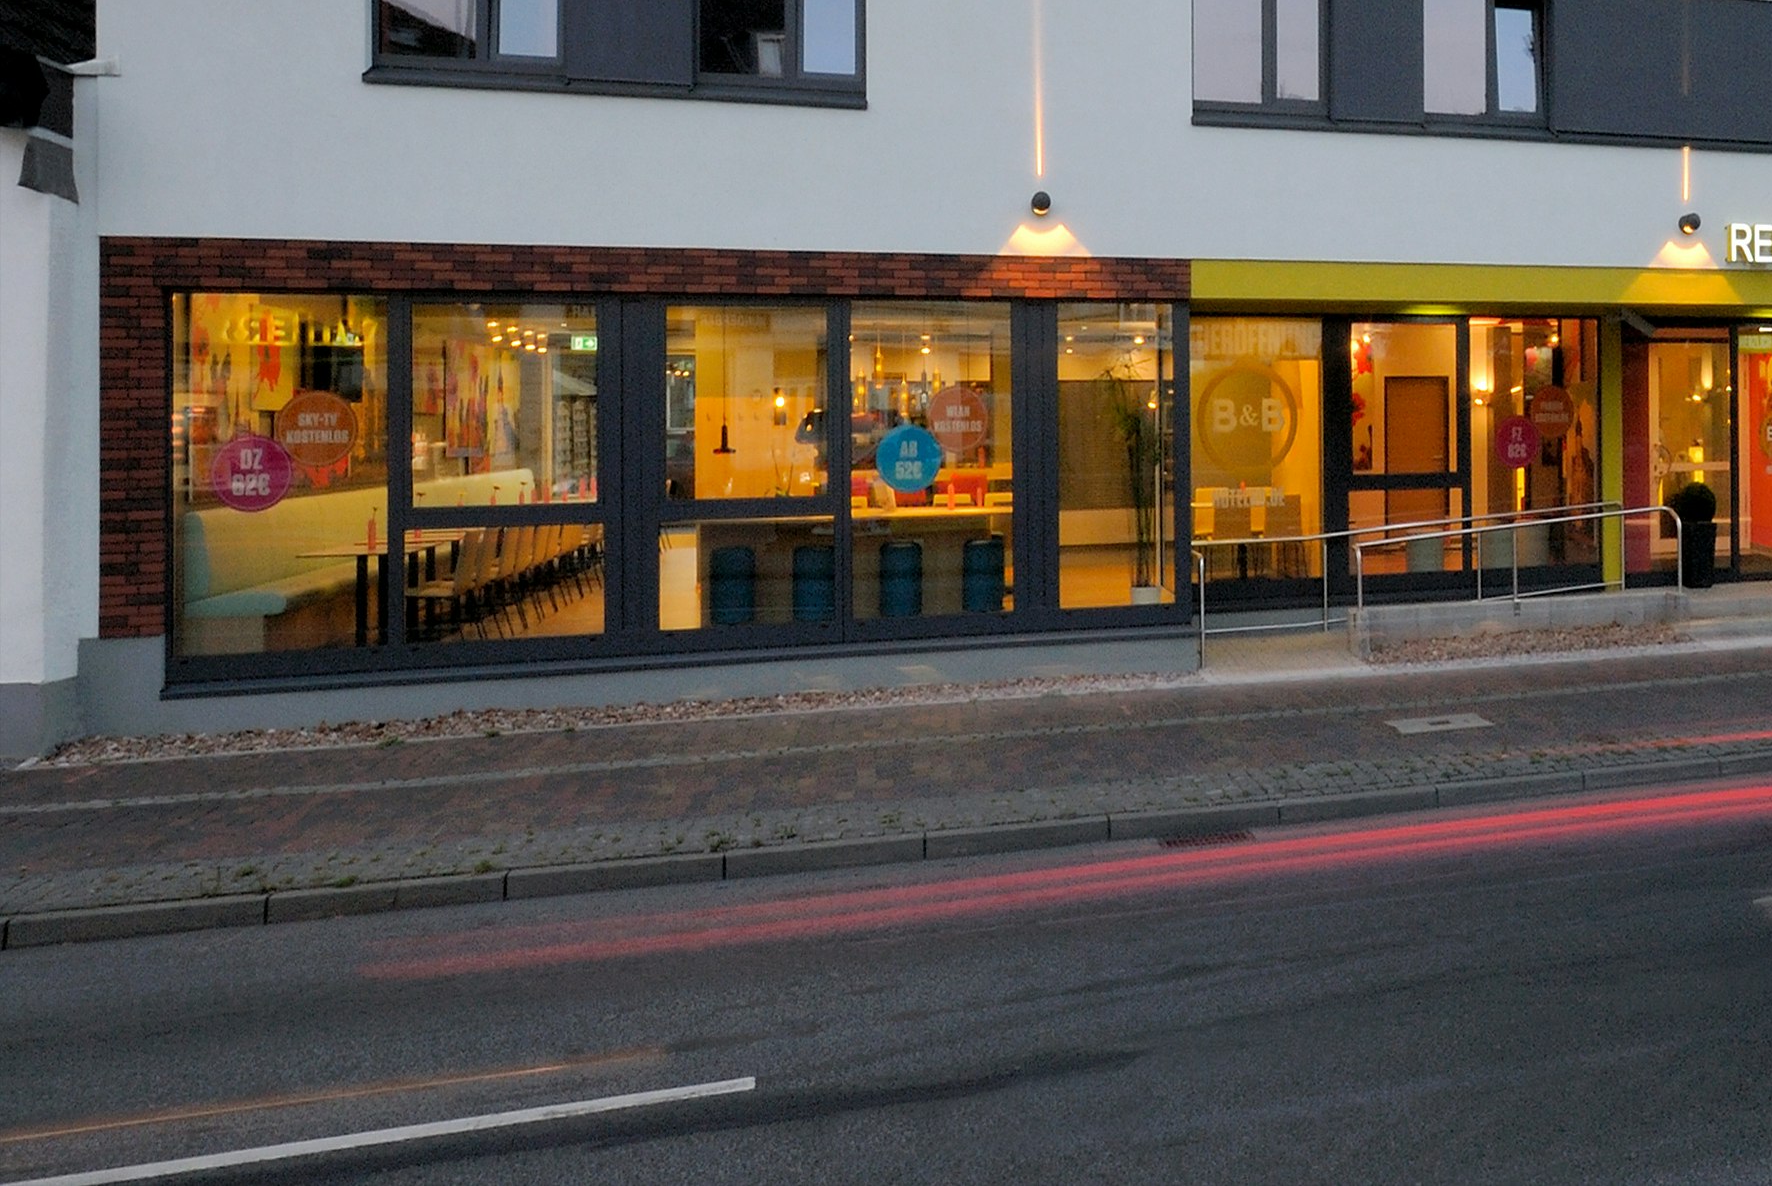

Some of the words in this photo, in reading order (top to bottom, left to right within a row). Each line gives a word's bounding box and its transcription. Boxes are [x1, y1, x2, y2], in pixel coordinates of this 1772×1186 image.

[297, 413, 338, 426] SKY-TV
[1212, 398, 1285, 433] B&B
[286, 429, 350, 444] KOSTENLOS
[900, 440, 918, 458] AB
[239, 447, 263, 470] DZ
